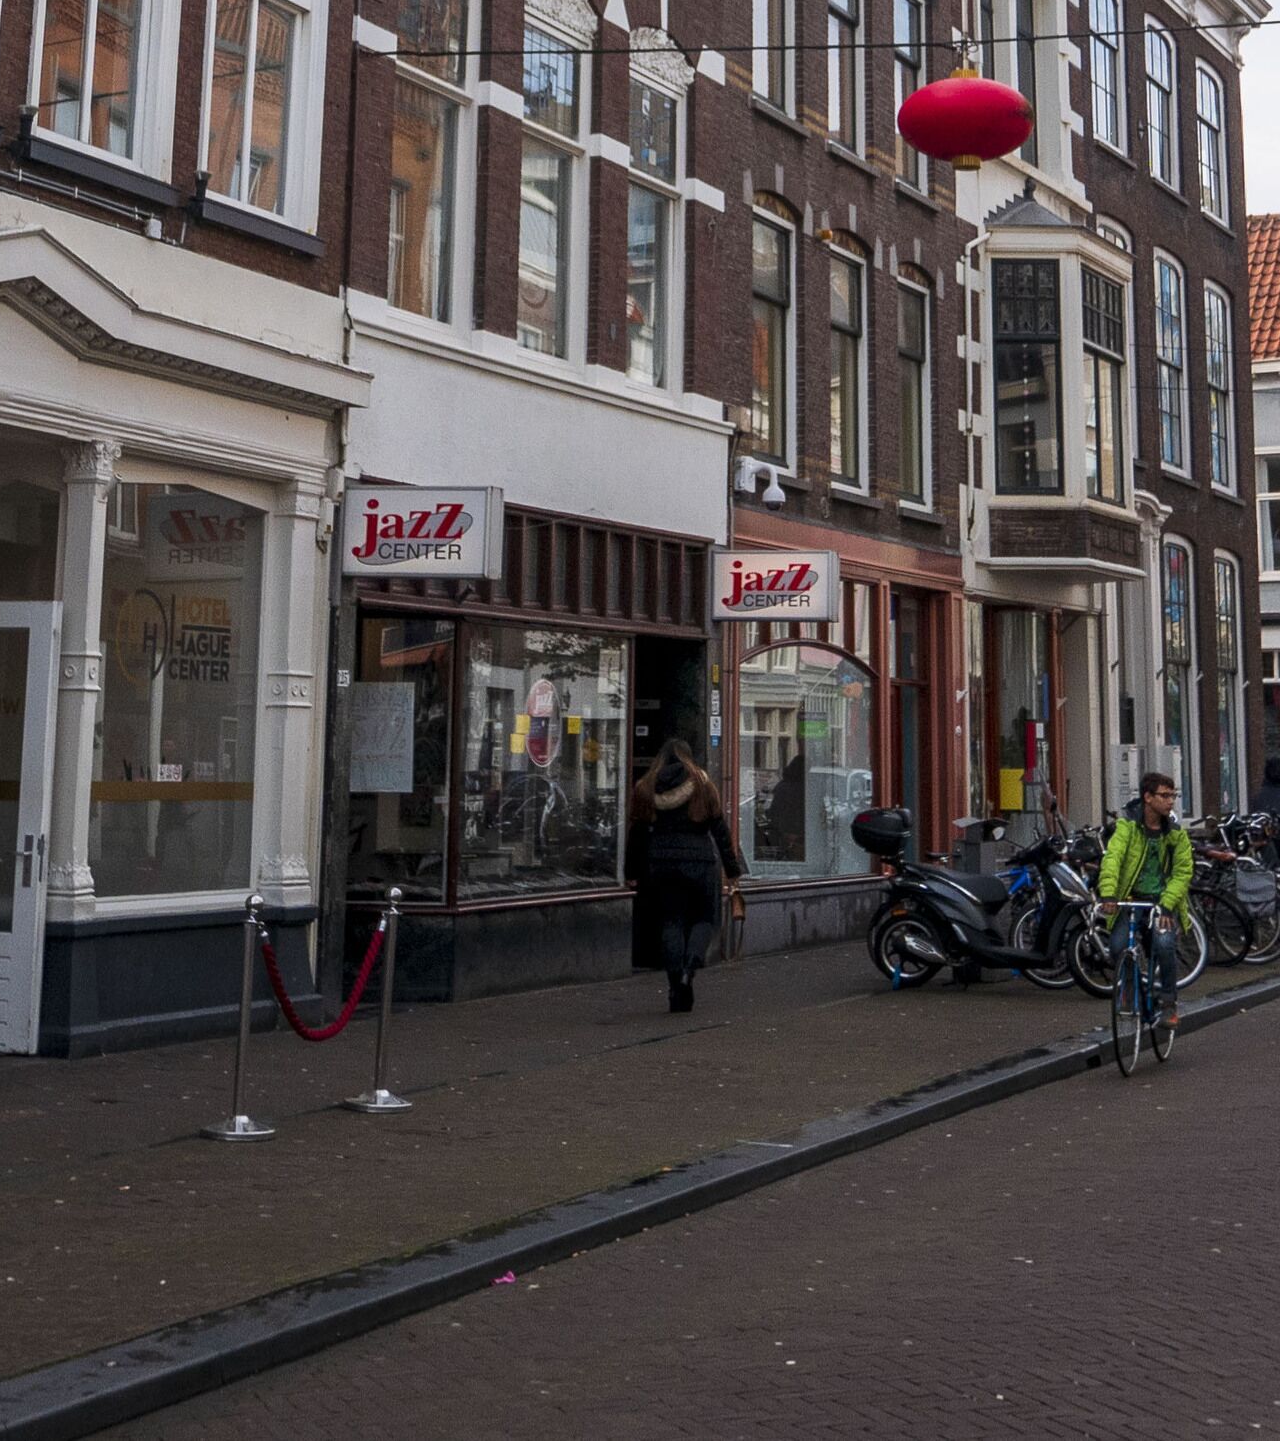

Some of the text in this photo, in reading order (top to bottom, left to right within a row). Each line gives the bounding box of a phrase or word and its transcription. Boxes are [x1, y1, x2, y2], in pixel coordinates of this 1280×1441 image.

[378, 542, 462, 560] CENTER
[743, 594, 811, 607] CENTER
[172, 631, 231, 658] HAGUE
[168, 657, 229, 682] CENTER
